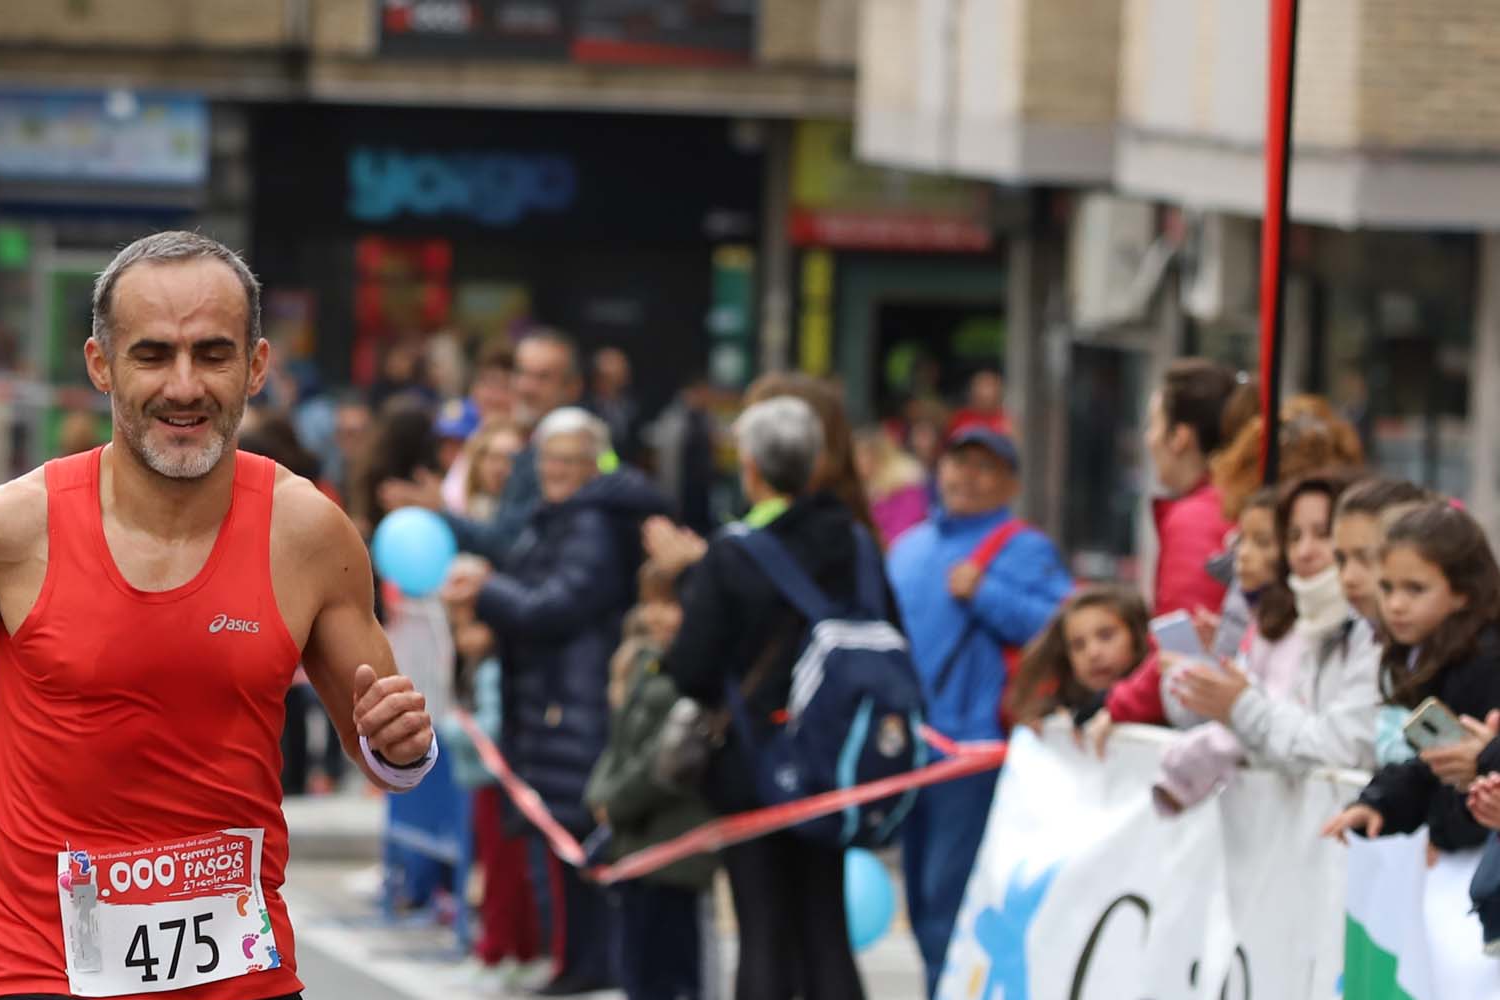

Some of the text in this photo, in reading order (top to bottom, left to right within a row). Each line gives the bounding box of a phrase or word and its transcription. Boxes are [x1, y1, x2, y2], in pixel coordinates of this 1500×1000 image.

[226, 618, 260, 633] asics
[227, 841, 244, 851] LOS
[184, 851, 244, 878] PASOS
[183, 879, 196, 891] 27
[226, 868, 244, 881] 2019
[125, 912, 220, 982] 475
